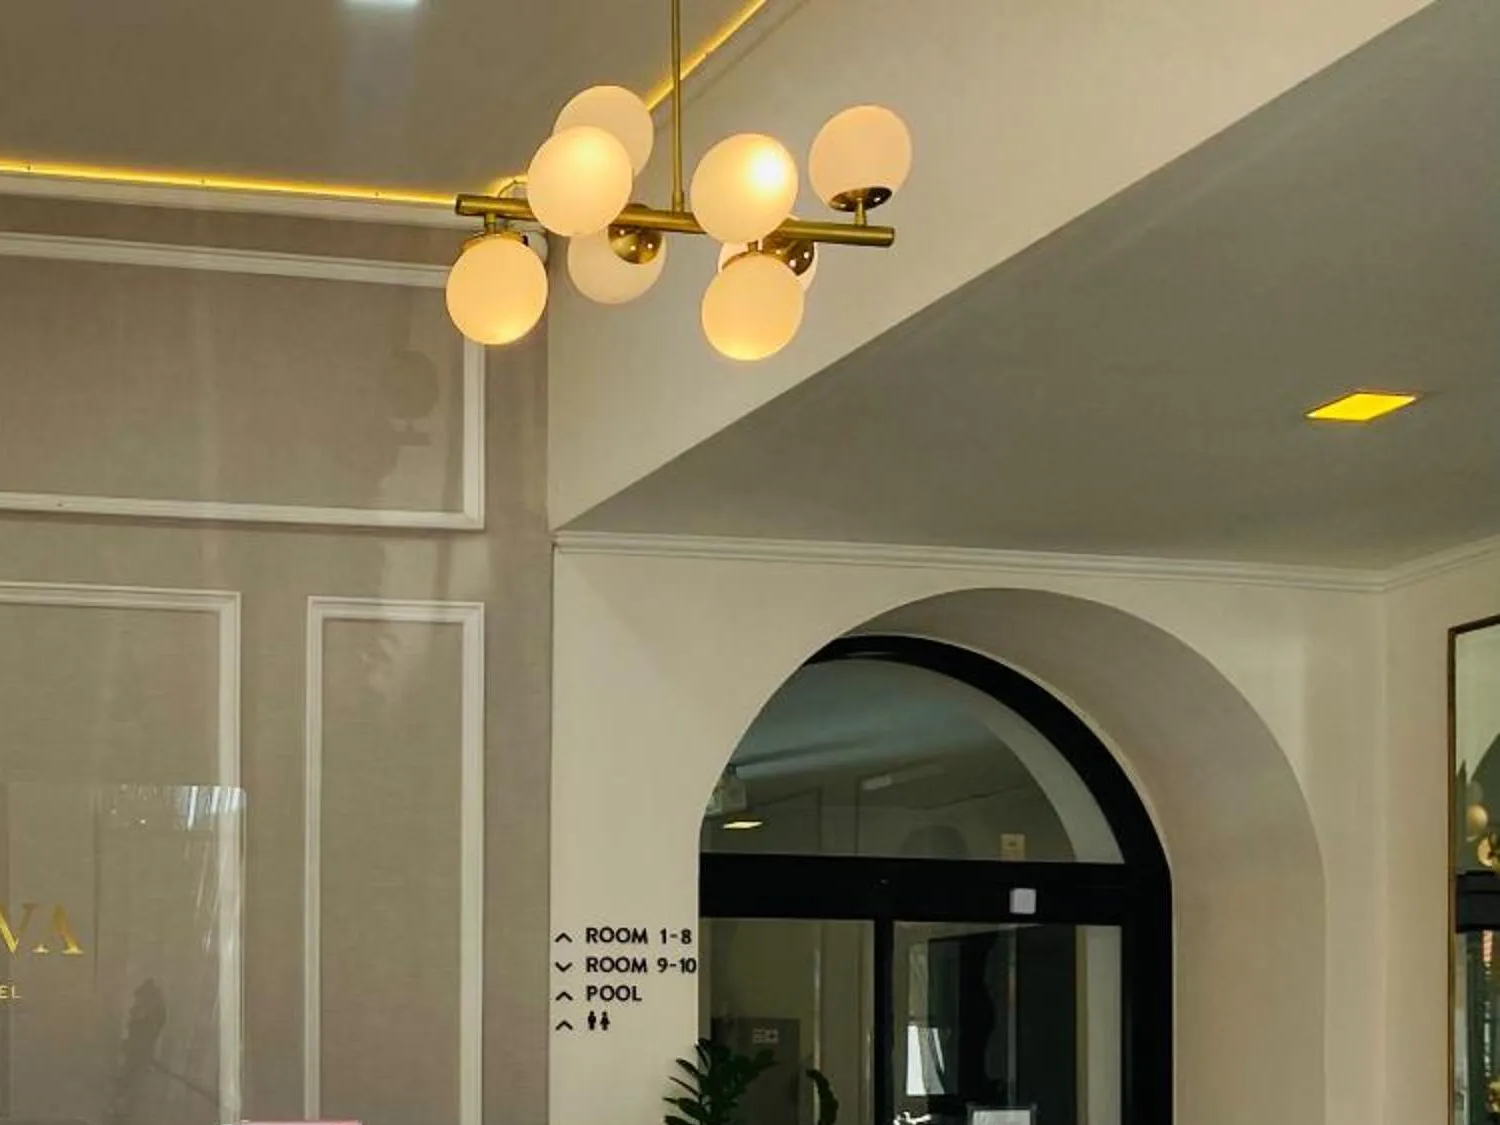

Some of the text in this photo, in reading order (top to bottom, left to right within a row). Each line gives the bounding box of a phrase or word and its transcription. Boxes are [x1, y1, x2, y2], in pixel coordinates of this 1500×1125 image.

[585, 927, 692, 945] ROOM 1-8
[585, 956, 697, 973] ROOM 9-10
[585, 985, 642, 1002] POOL
